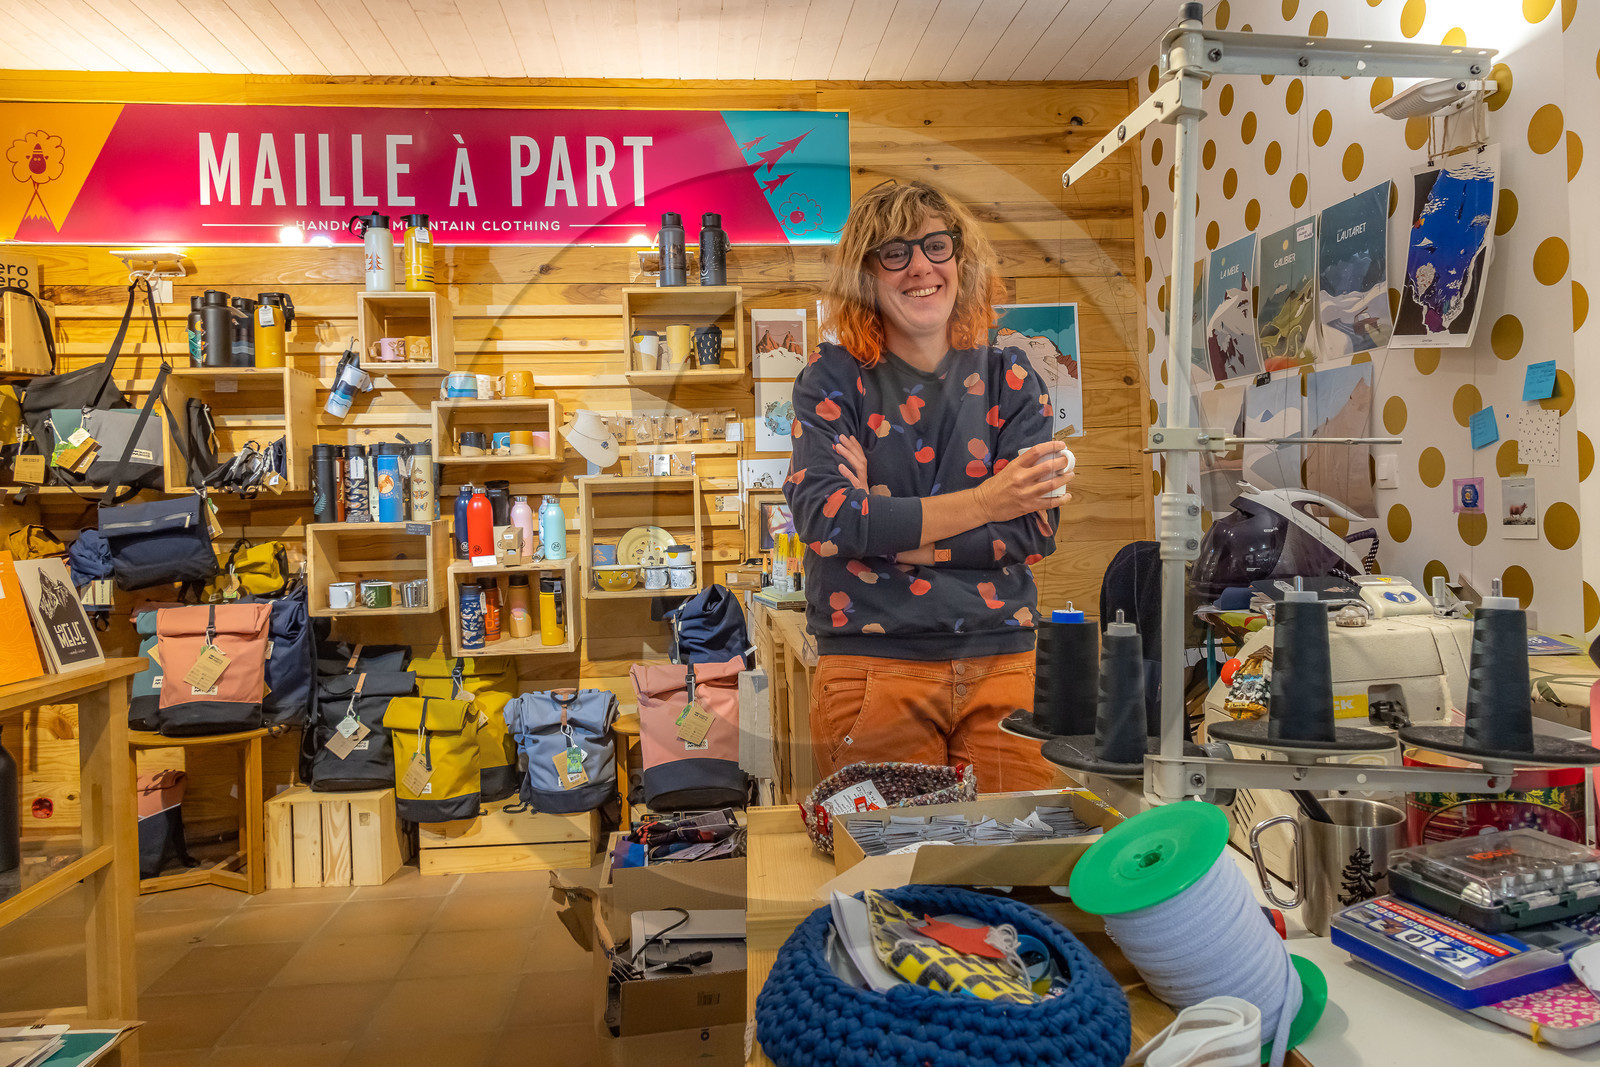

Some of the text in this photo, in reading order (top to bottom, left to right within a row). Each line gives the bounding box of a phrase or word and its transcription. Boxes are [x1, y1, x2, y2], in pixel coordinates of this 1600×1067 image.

[199, 132, 653, 207] MAILLE À PART
[296, 220, 560, 231] HANDMA MNTAIN CLOTHING
